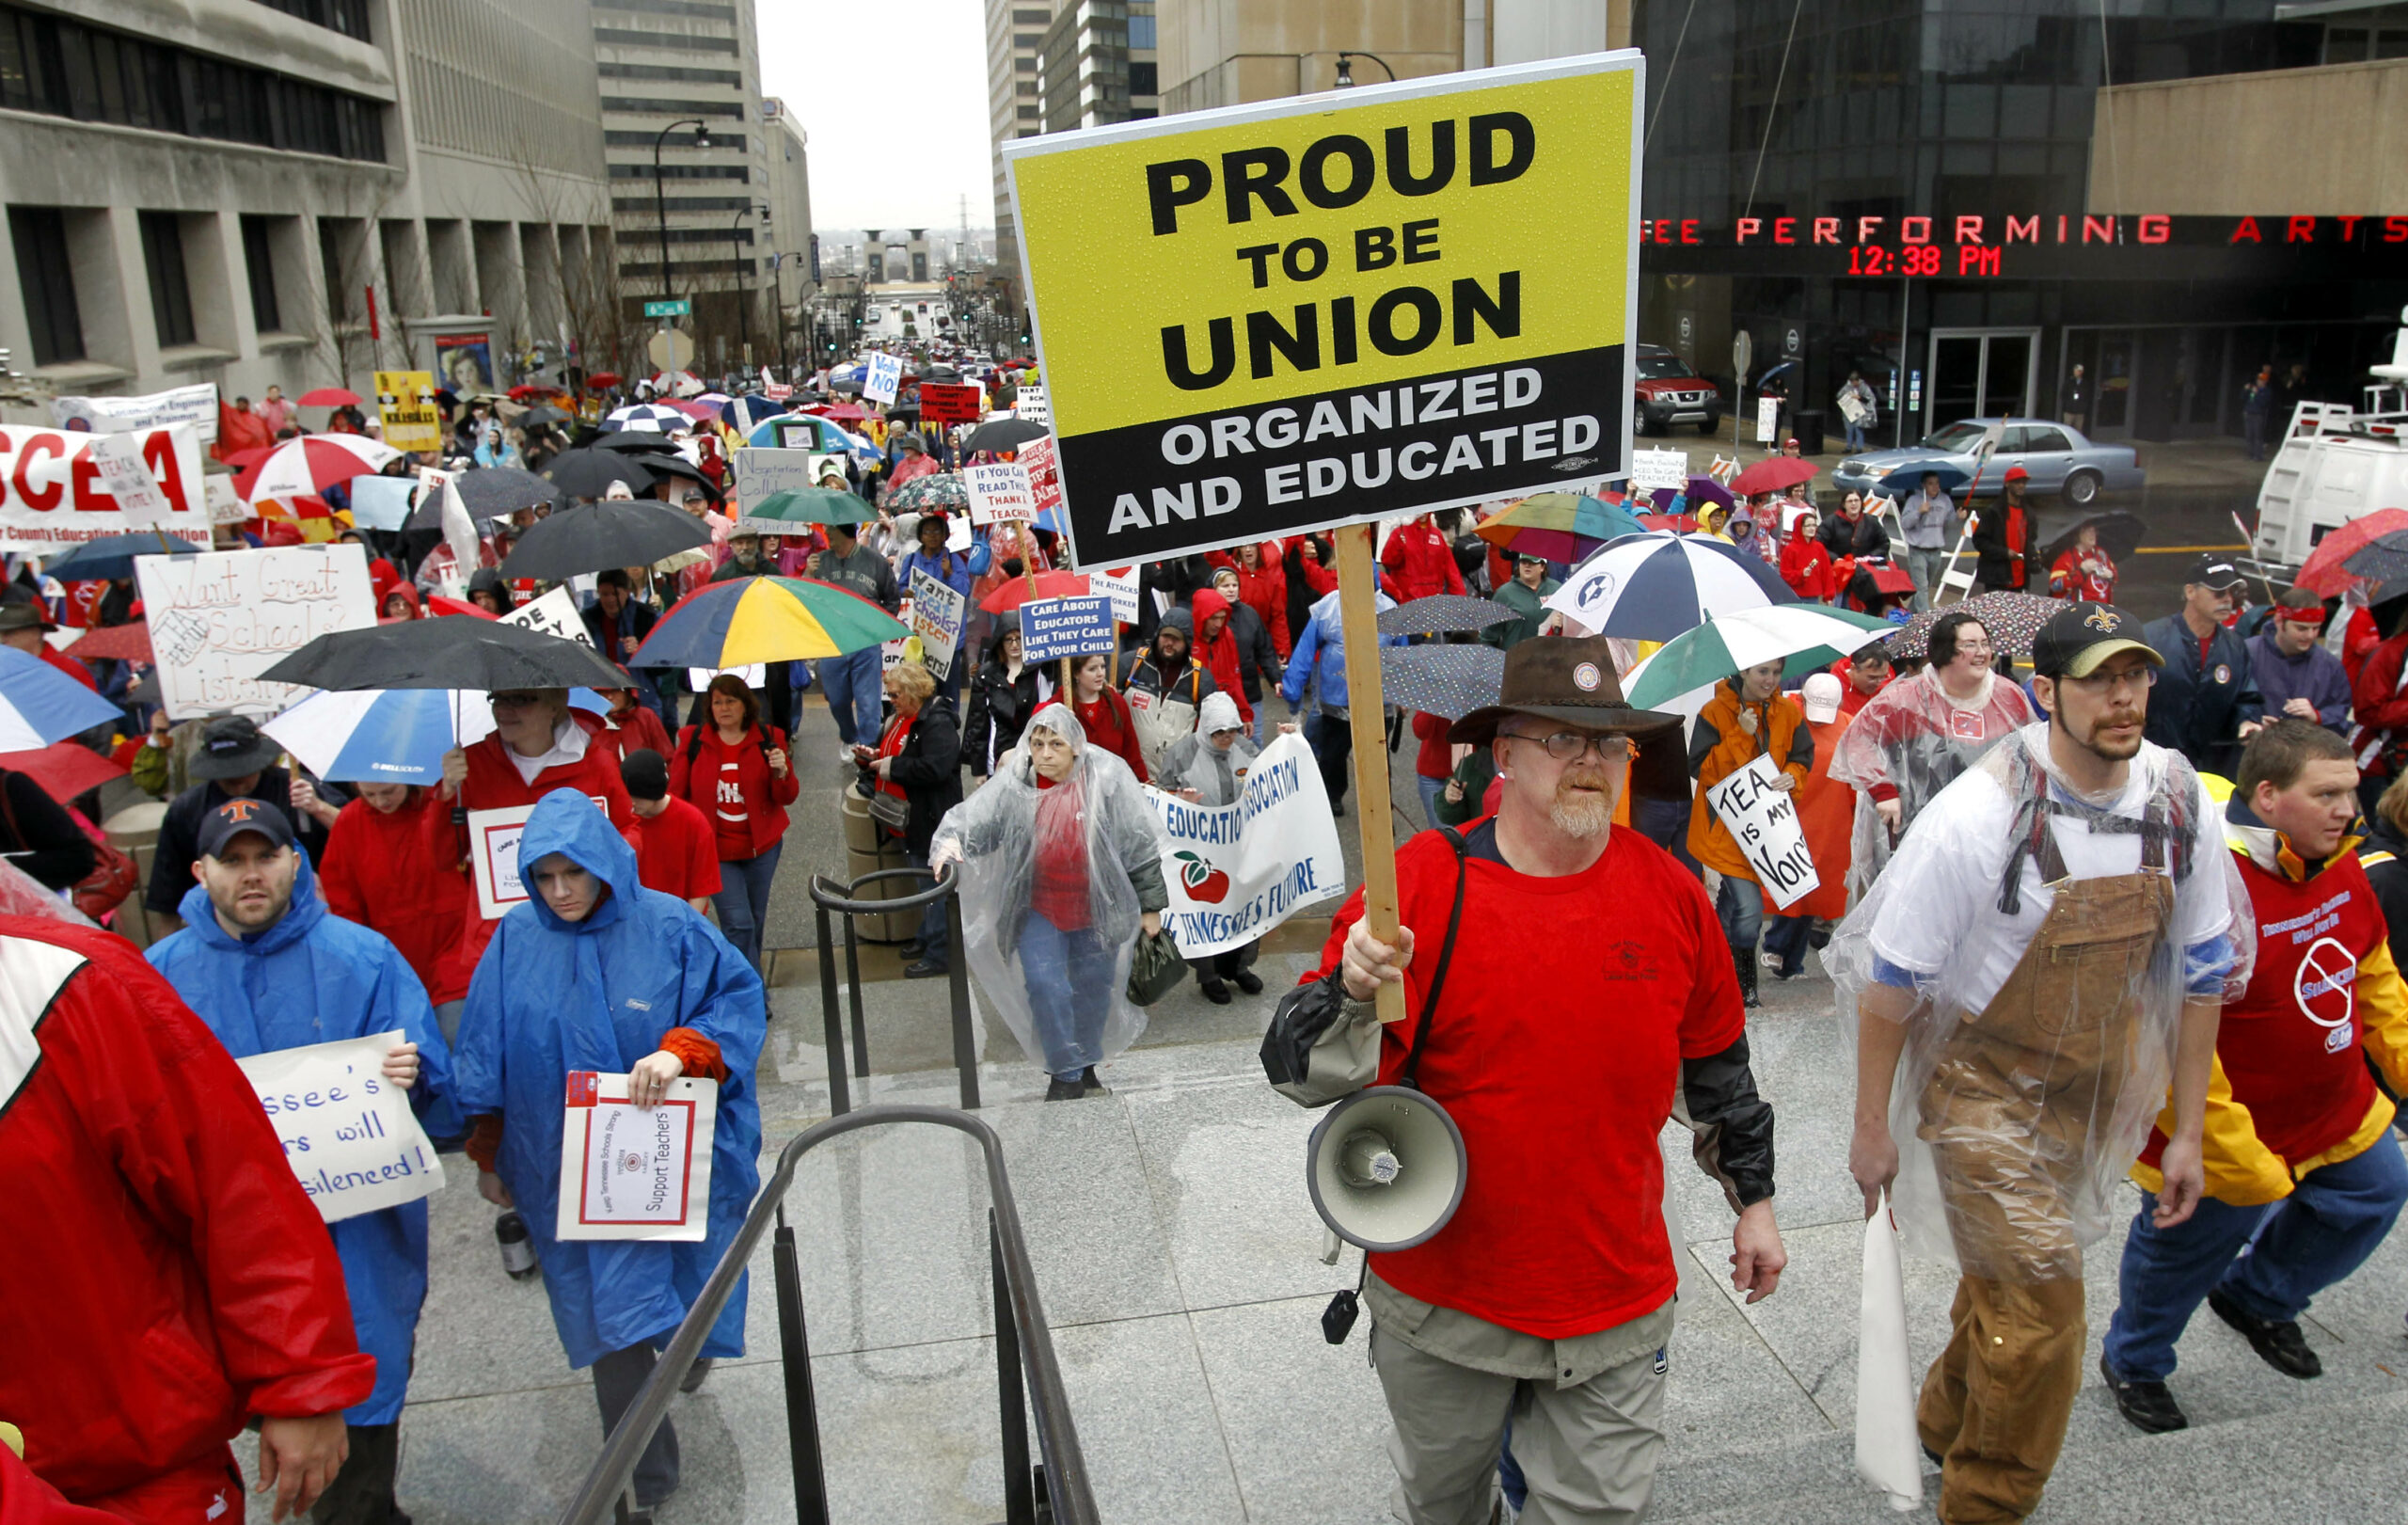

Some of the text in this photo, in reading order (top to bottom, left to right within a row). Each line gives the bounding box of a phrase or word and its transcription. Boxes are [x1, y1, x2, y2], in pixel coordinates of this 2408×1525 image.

[1146, 111, 1535, 236] PROUD
[1736, 214, 2171, 245] PERFORMING
[2230, 215, 2408, 244] ARTS
[1236, 218, 1441, 289] TO BE
[1848, 246, 2002, 276] 12:38 PM
[1160, 270, 1521, 391] UNION
[872, 373, 898, 394] NO!
[1161, 367, 1543, 466] ORGANIZED
[988, 467, 1009, 478] YOU
[1106, 415, 1601, 535] AND EDUCATED
[978, 482, 1007, 494] READ
[987, 495, 1022, 506] THANK
[990, 509, 1030, 520] TEACHER
[7, 527, 52, 543] County
[150, 555, 340, 607] Want Great
[911, 567, 957, 606] Want
[1105, 581, 1139, 596] ATTACKS
[1031, 600, 1101, 617] CARE ABOUT
[1034, 614, 1100, 631] EDUCATORS
[1024, 641, 1114, 662] FOR YOUR CHILD
[1025, 627, 1112, 647] LIKE THEY CARE
[1719, 768, 1774, 818] TEA
[220, 800, 260, 824] T
[1740, 799, 1791, 846] IS MY
[1753, 834, 1814, 895] VOIC
[1268, 857, 1319, 918] FUTURE
[336, 1110, 386, 1142] will
[606, 1110, 621, 1132] Strong
[601, 1133, 612, 1159] Schools
[600, 1160, 610, 1195] Tennessee
[646, 1113, 670, 1212] Support Teachers
